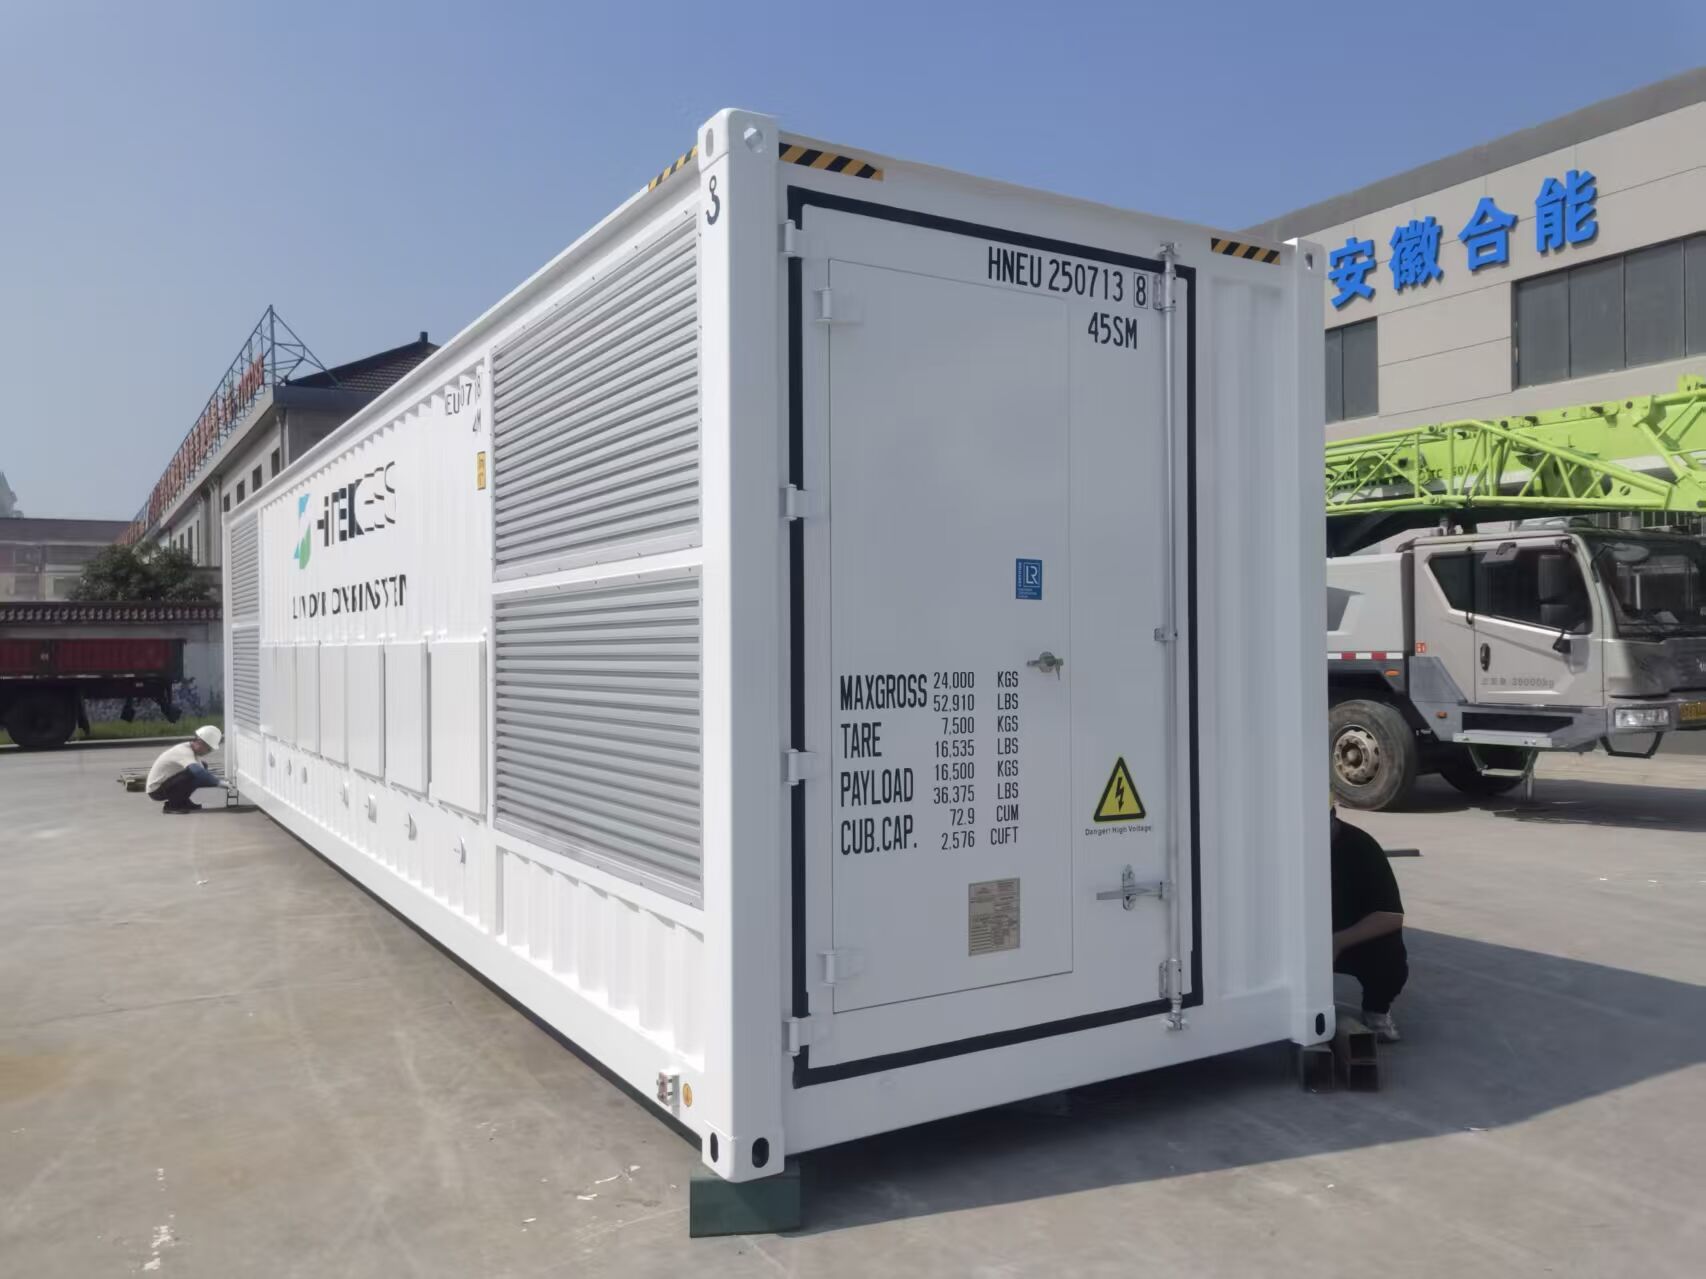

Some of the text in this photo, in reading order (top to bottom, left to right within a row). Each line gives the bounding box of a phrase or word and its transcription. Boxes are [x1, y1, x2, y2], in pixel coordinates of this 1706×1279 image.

[1328, 169, 1598, 309] 安徽合能
[988, 246, 1146, 306] HNEU 250713 8
[1088, 312, 1137, 349] 45SM
[840, 674, 927, 710] MAXGROSS
[997, 671, 1019, 688] KGS
[997, 693, 1019, 710] LBS
[841, 722, 882, 758] TARE
[997, 716, 1019, 732] KGS
[997, 738, 1019, 755] LBS
[841, 768, 914, 807] PAYLOAD
[997, 760, 1019, 777] KGS
[997, 782, 1019, 799] LBS
[841, 805, 1019, 855] CUB.CAP. 72.9 CUM
[990, 827, 1019, 845] CUFT
[1112, 826, 1127, 834] High
[1128, 825, 1152, 833] Voltage
